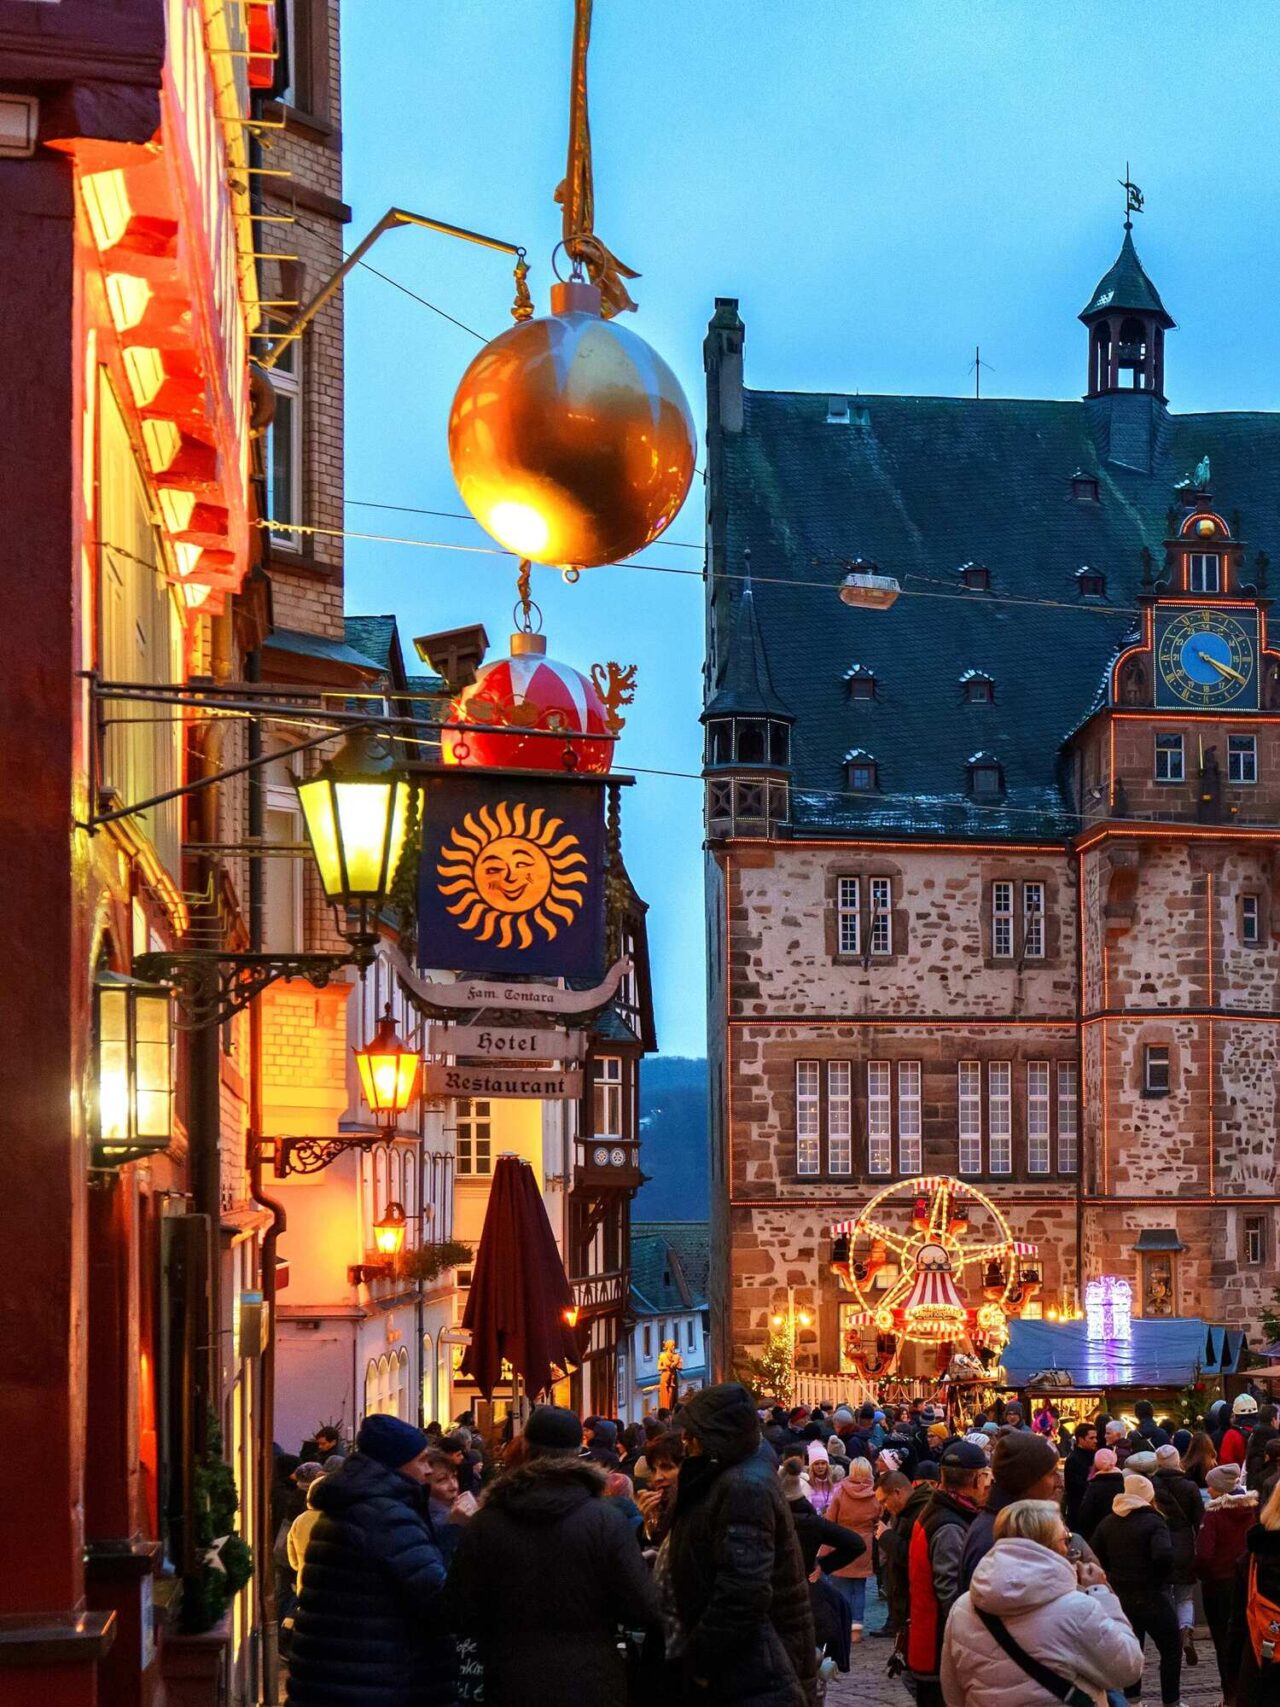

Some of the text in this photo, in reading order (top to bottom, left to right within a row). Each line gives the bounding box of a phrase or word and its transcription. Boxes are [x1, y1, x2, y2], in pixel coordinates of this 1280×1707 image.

[467, 986, 498, 1001] Fam.
[477, 1032, 537, 1054] Hotel
[445, 1072, 565, 1094] Restaurant
